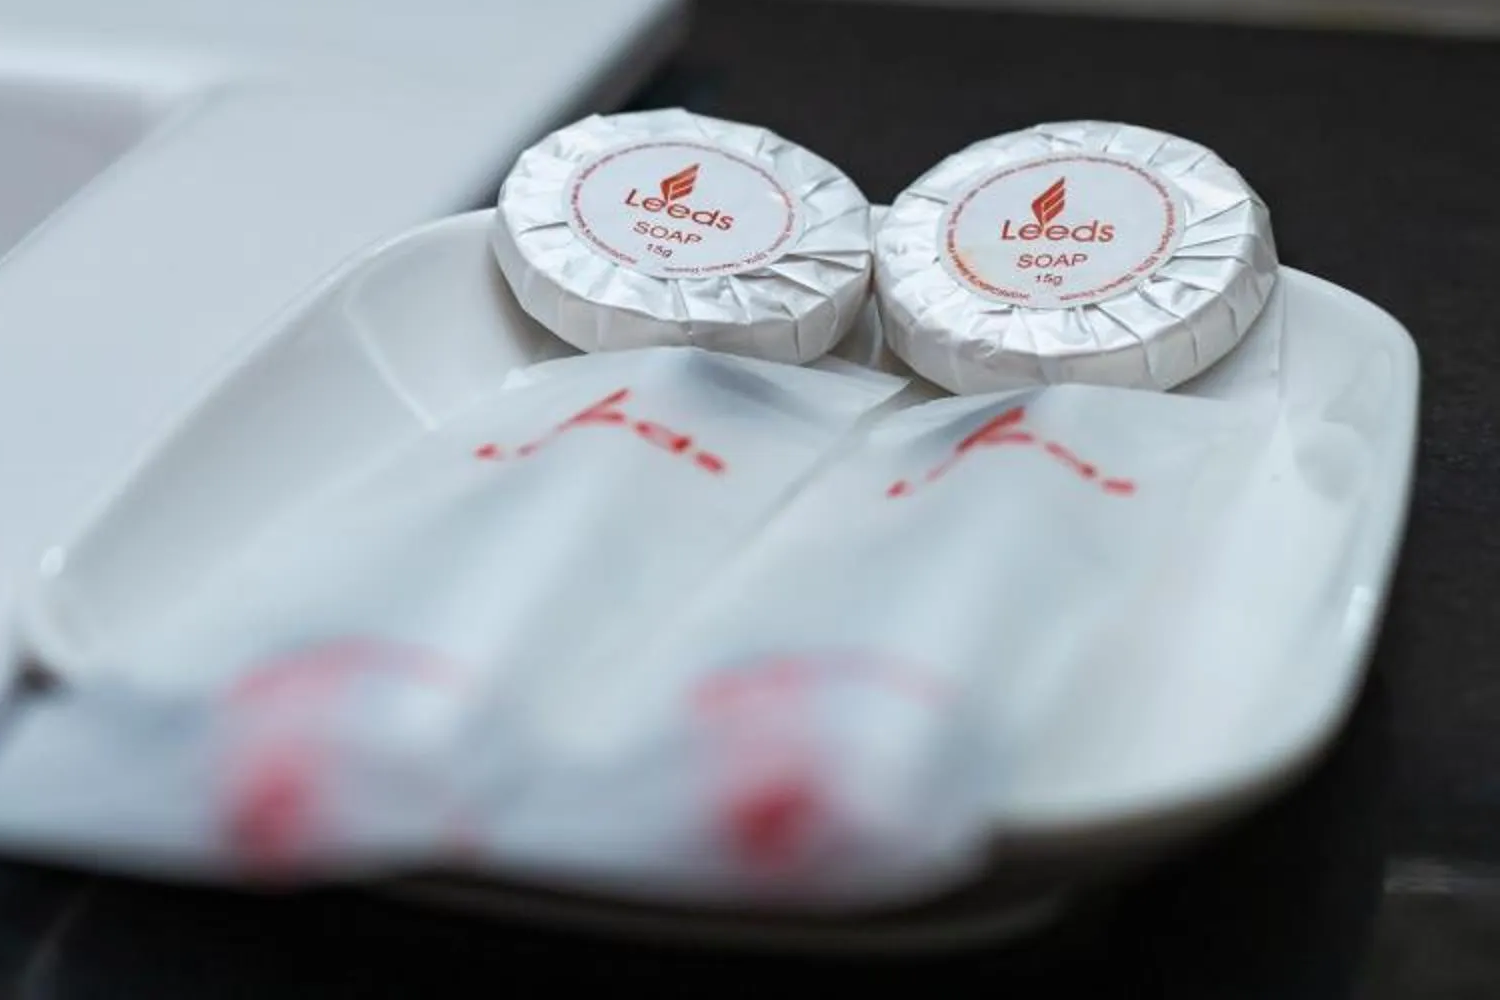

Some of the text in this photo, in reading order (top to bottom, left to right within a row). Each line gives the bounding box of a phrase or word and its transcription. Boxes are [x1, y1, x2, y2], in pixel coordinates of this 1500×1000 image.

[625, 189, 734, 230] Leeds
[632, 221, 702, 243] SOAP
[1001, 220, 1115, 242] Leeds
[647, 243, 673, 258] 15g
[1016, 254, 1088, 268] SOAP
[1034, 274, 1063, 286] 15g
